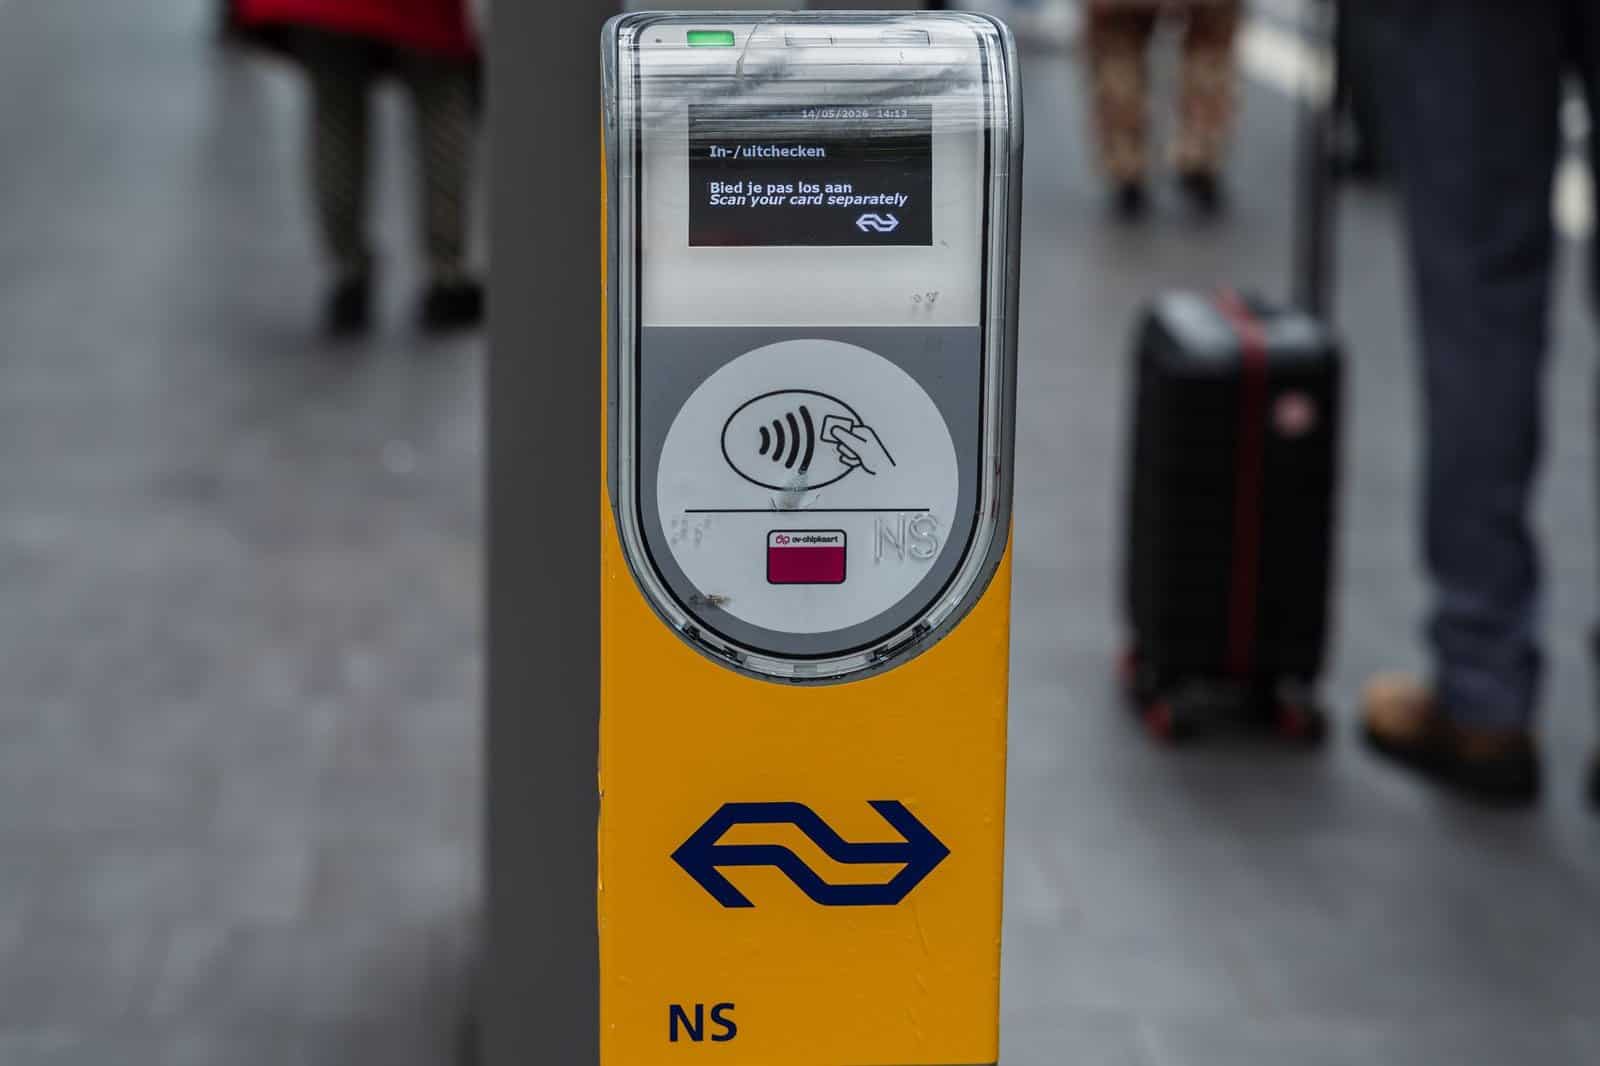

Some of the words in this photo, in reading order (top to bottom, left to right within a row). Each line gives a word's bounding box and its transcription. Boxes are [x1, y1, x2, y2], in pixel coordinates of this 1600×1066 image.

[801, 109, 869, 120] 14/05/2026
[709, 145, 825, 159] In-/uitchecken
[710, 182, 743, 194] Bied
[747, 182, 762, 196] je
[767, 184, 793, 197] pas
[799, 182, 820, 194] los
[825, 184, 852, 194] aan
[709, 194, 746, 206] Scan
[751, 196, 785, 207] your
[790, 193, 823, 205] card
[827, 193, 908, 207] separately
[874, 514, 938, 563] NS
[669, 1002, 737, 1042] NS
